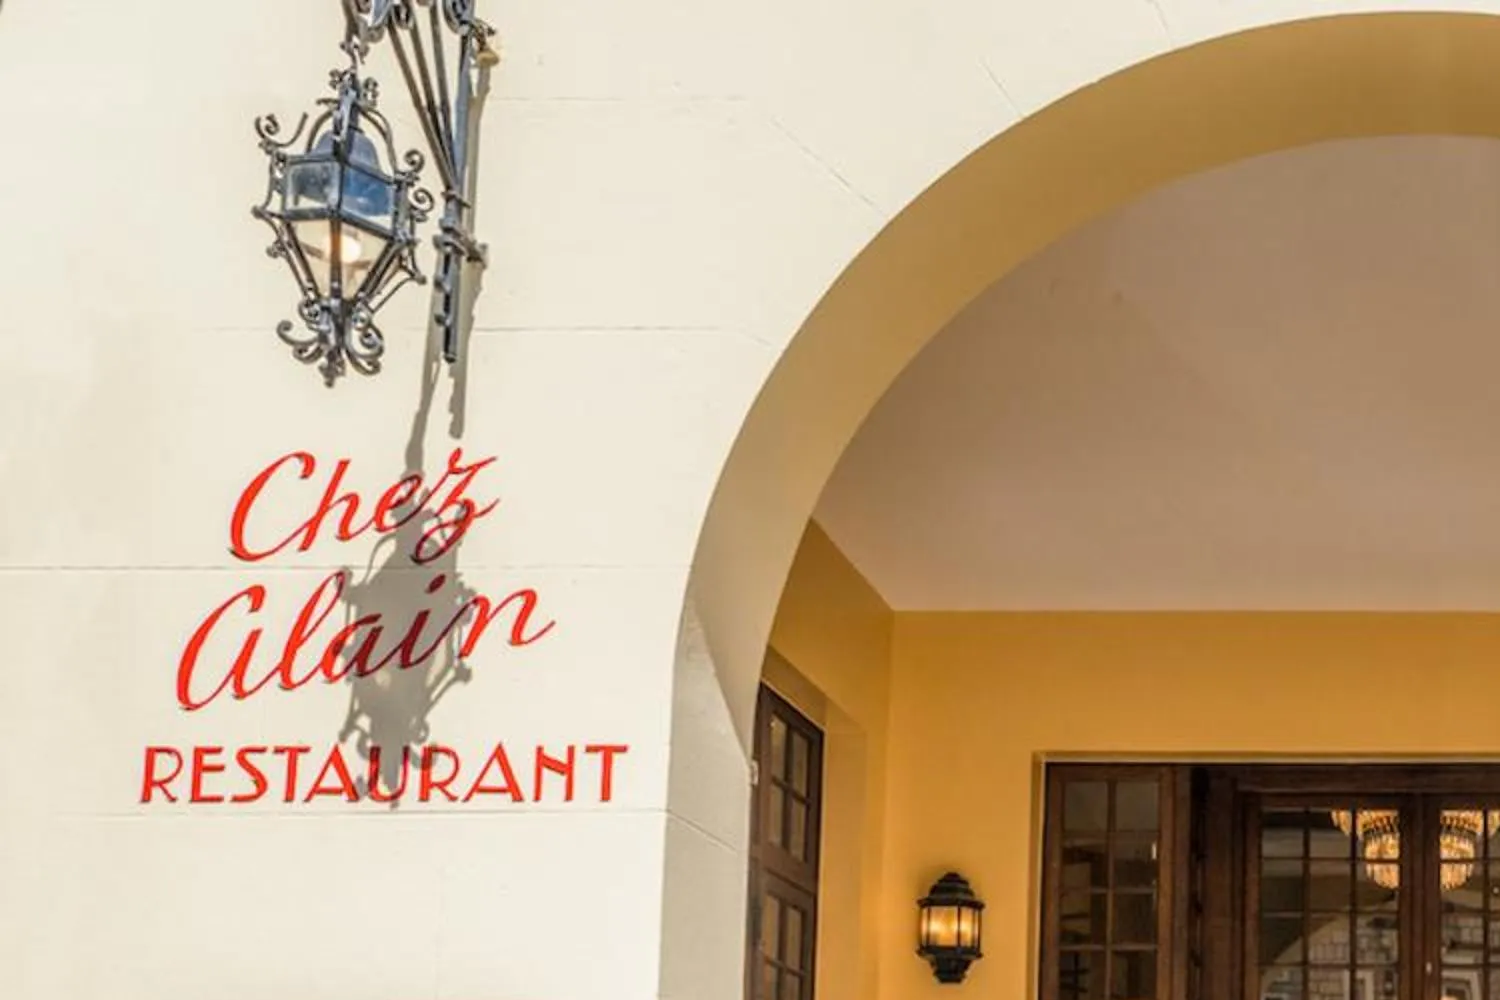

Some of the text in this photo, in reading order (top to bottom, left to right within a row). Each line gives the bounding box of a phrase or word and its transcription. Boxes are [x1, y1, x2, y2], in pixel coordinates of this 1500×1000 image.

[229, 447, 499, 564] Chez
[175, 571, 556, 712] Alain
[139, 743, 629, 804] RESTAURANT
